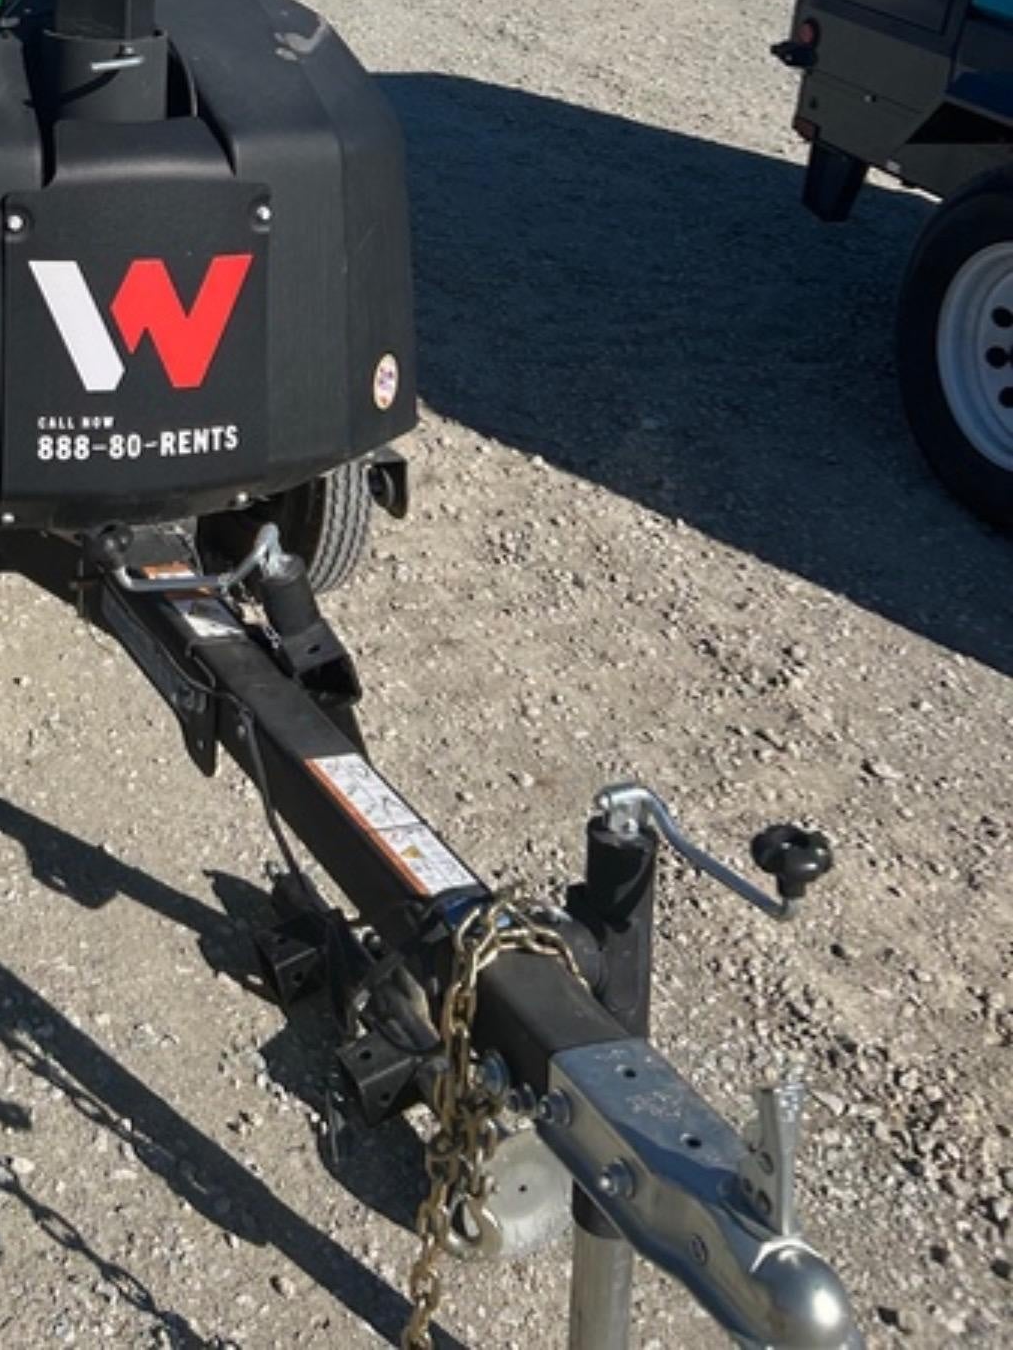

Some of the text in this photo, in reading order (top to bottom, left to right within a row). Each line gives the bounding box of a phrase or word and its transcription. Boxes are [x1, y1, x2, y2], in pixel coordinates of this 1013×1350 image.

[37, 416, 115, 430] CALL NOW
[37, 425, 239, 461] 888-80-RENTS
